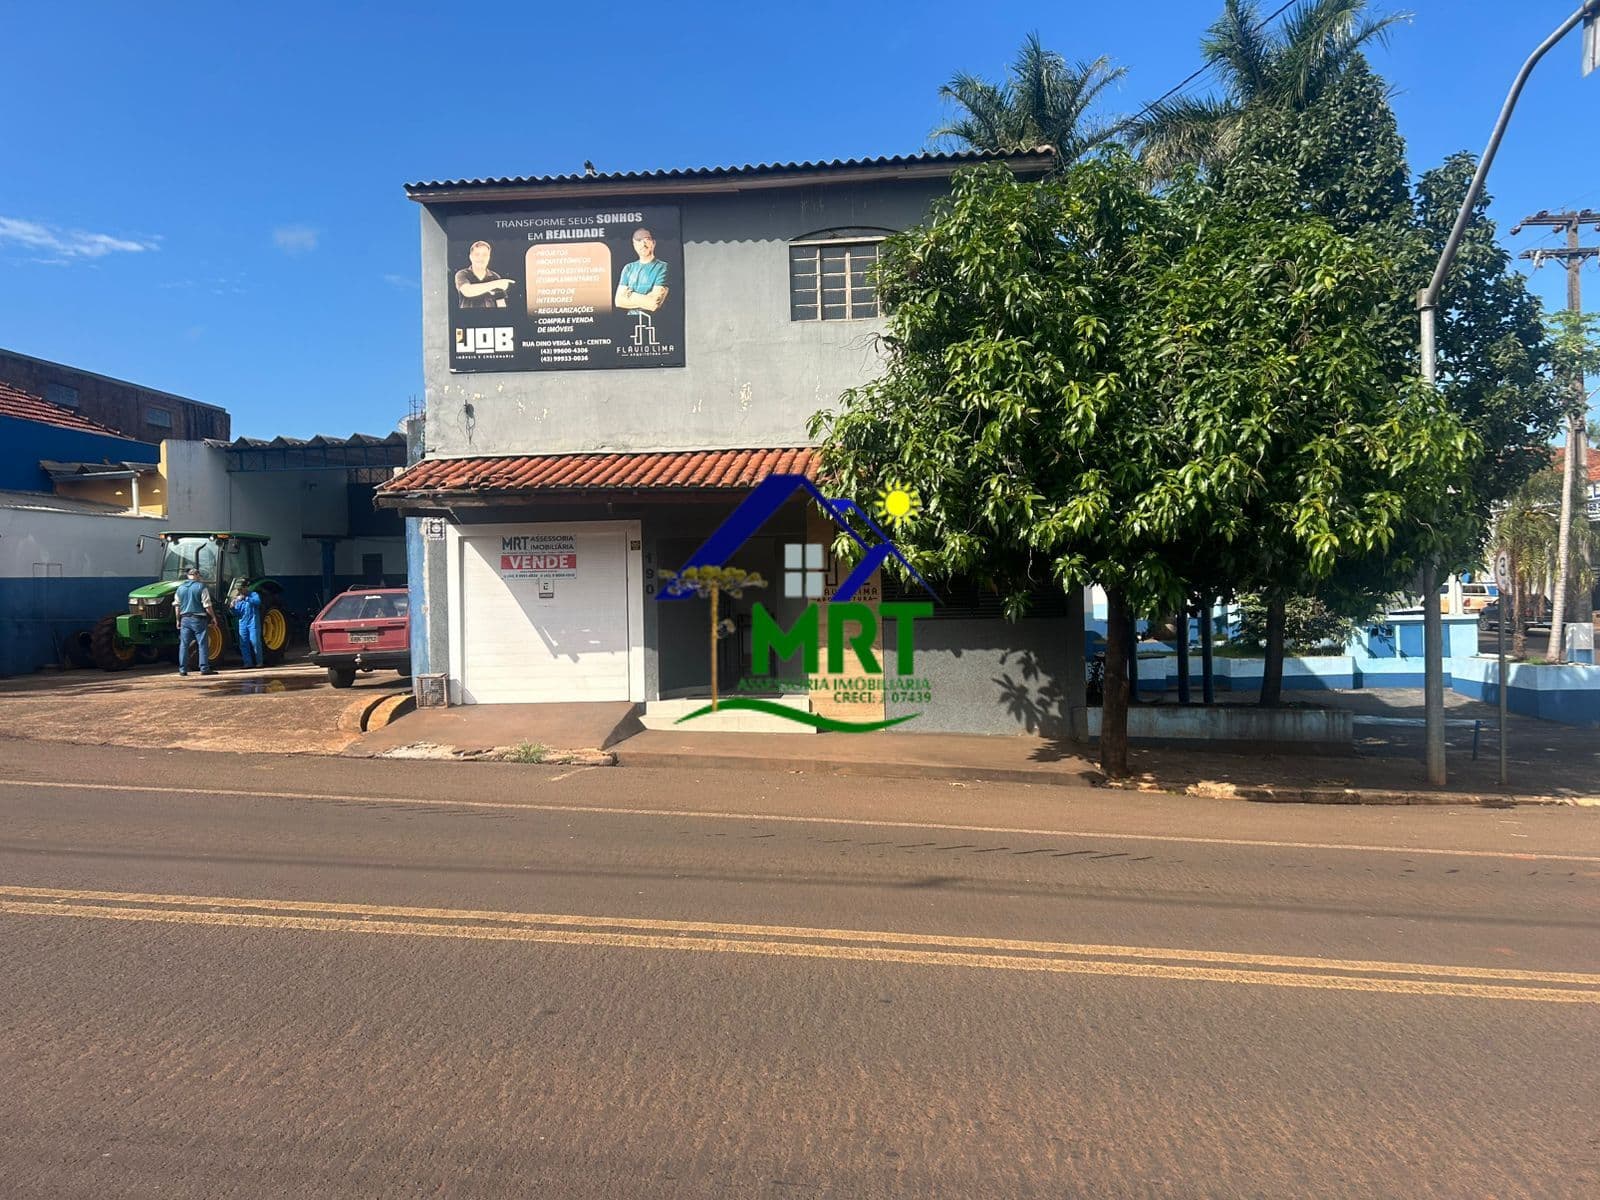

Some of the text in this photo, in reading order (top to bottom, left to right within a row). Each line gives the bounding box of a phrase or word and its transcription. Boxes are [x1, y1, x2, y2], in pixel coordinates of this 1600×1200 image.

[495, 212, 643, 228] TRANSFORME SEUS SONHOS
[527, 228, 606, 240] EM REALIDADE
[536, 296, 573, 304] INTERIORES
[538, 306, 594, 315] REGULARIZAÇÕES
[538, 317, 565, 325] COMPRA
[547, 325, 574, 333] IMÓVEIS
[456, 326, 514, 354] JOB
[652, 344, 675, 352] LIMA
[502, 536, 530, 550] MRT
[509, 555, 569, 569] VENDE
